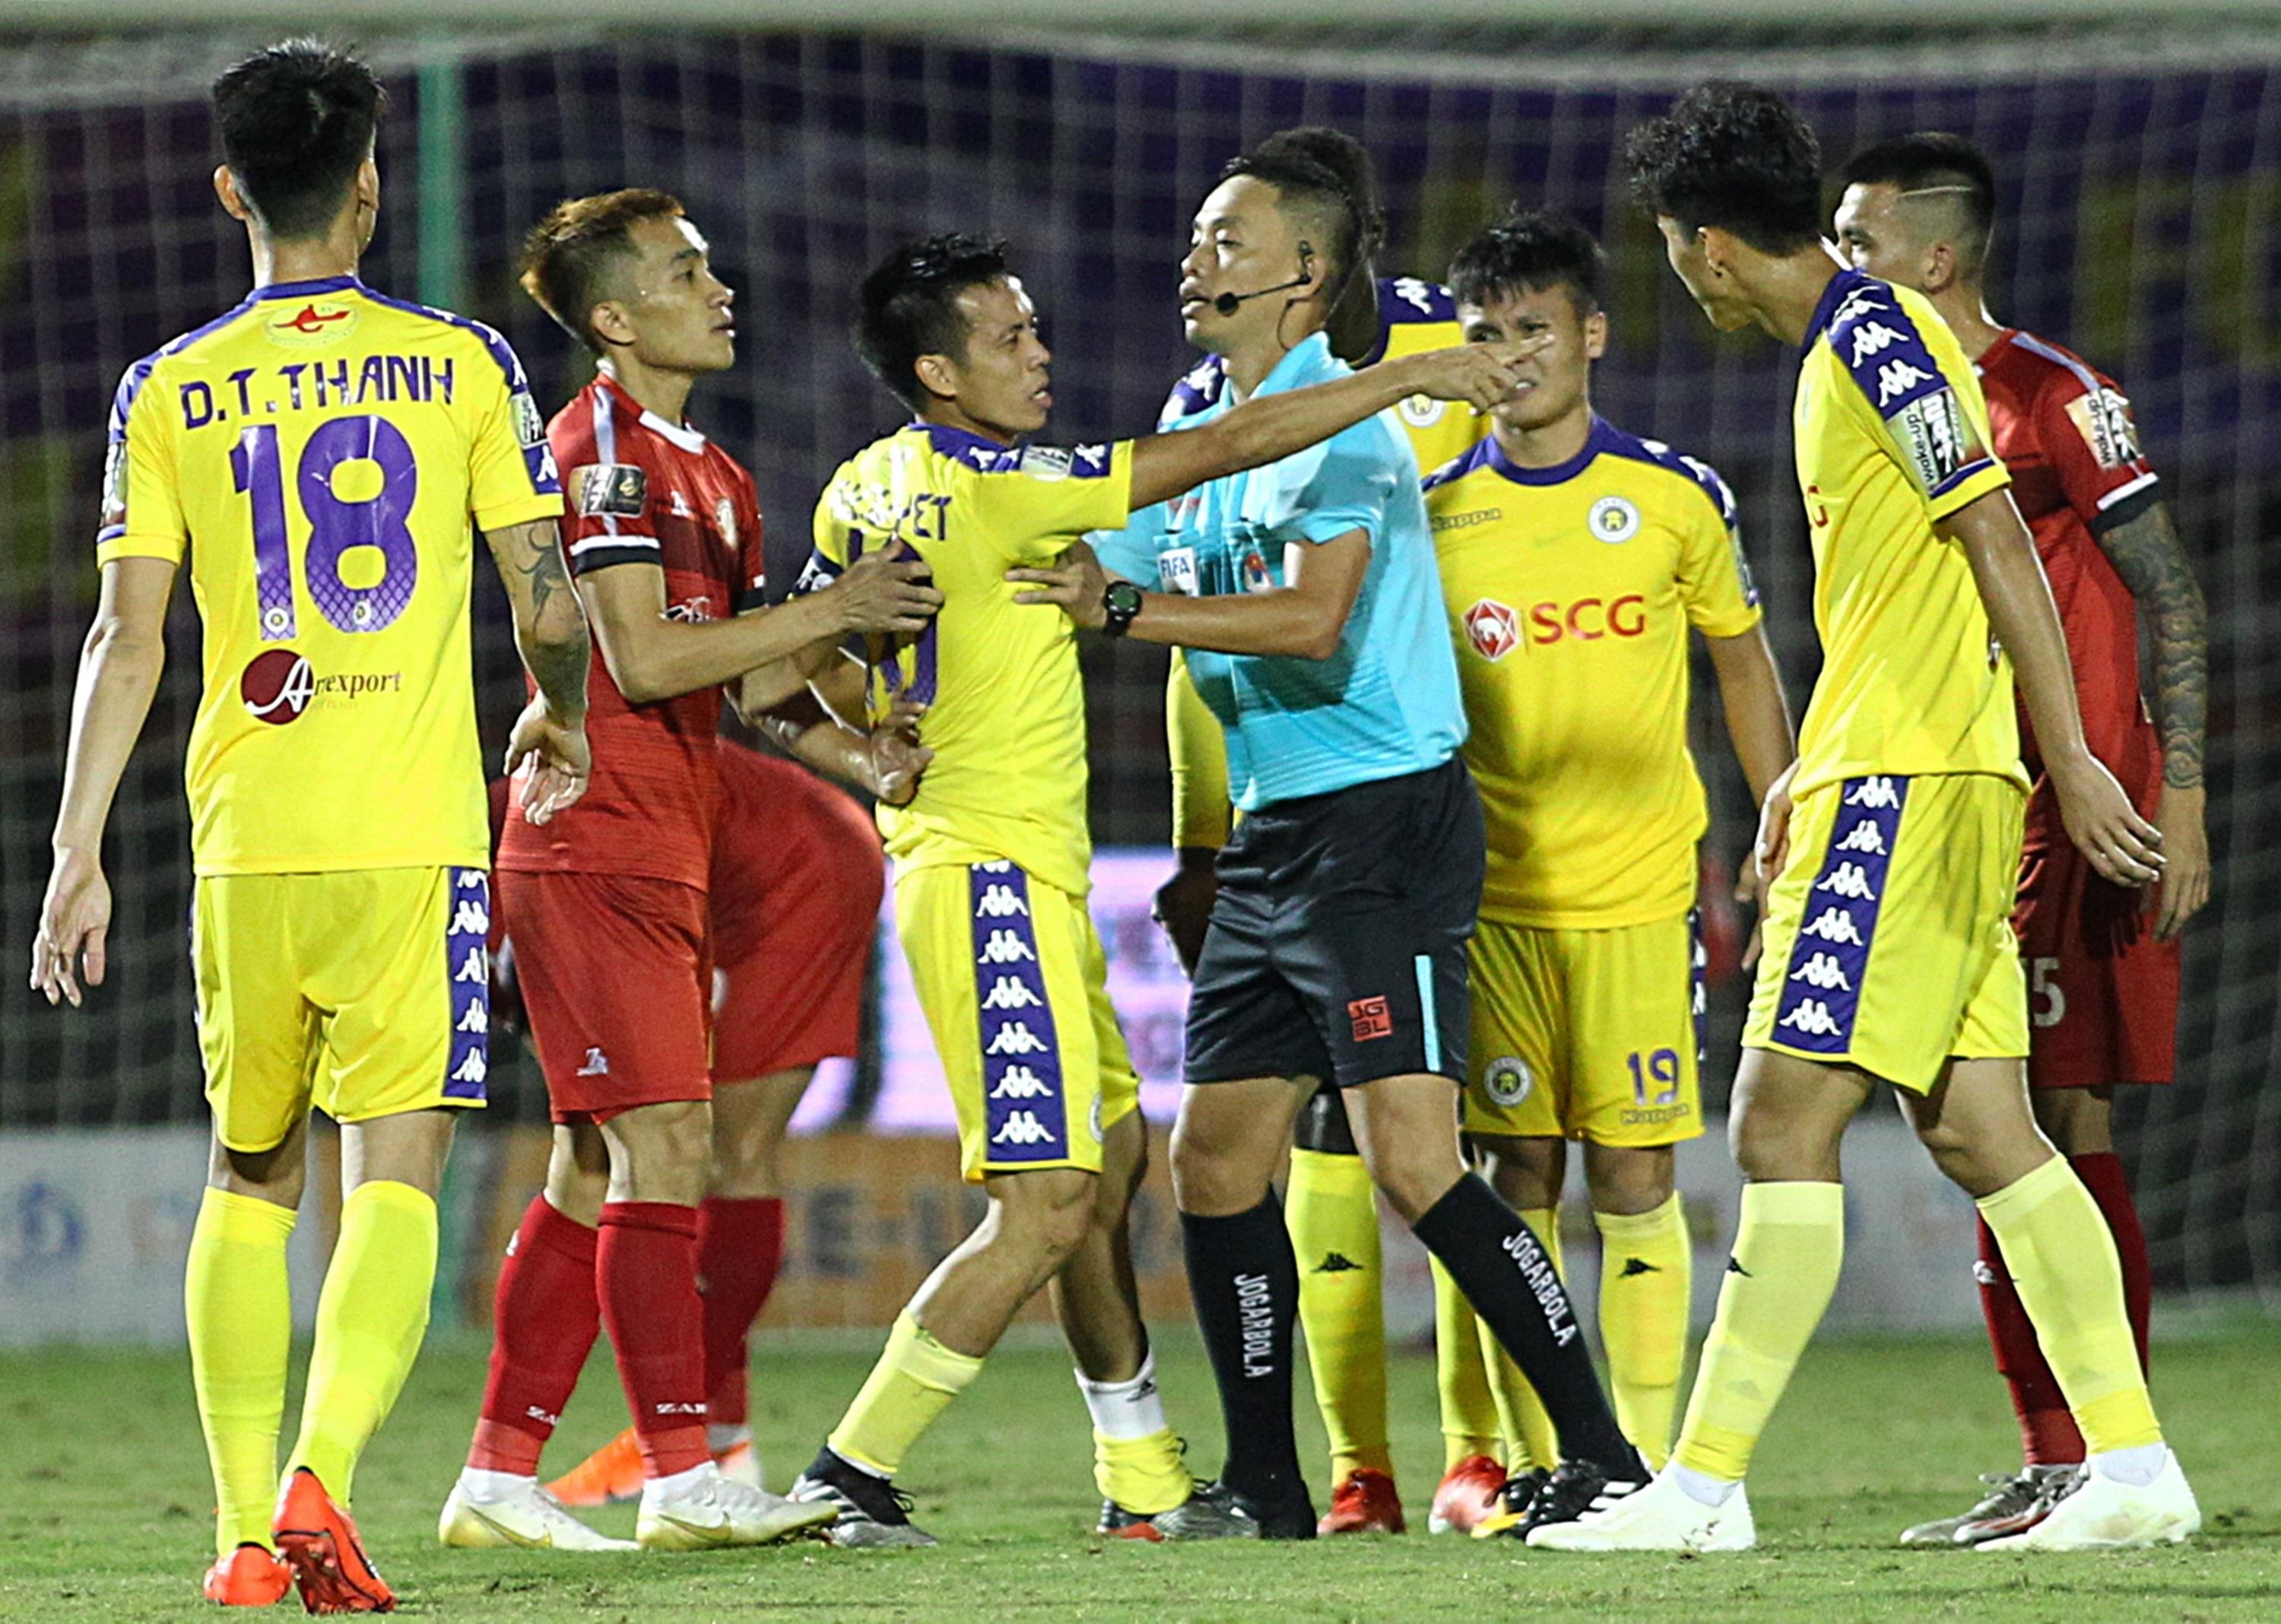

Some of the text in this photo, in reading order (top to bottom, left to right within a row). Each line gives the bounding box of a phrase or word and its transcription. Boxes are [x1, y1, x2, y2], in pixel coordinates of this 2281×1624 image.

[179, 355, 454, 430] D.T.THANH
[1905, 413, 1936, 482] wake-up
[228, 414, 417, 641] 18
[1160, 557, 1191, 578] FIFA
[1530, 594, 1645, 645] SCG
[2020, 956, 2066, 1027] 5
[1627, 1048, 1679, 1106] 19
[1502, 1229, 1578, 1347] JOGARBOLA
[1233, 1274, 1274, 1378] JOGARBOLA
